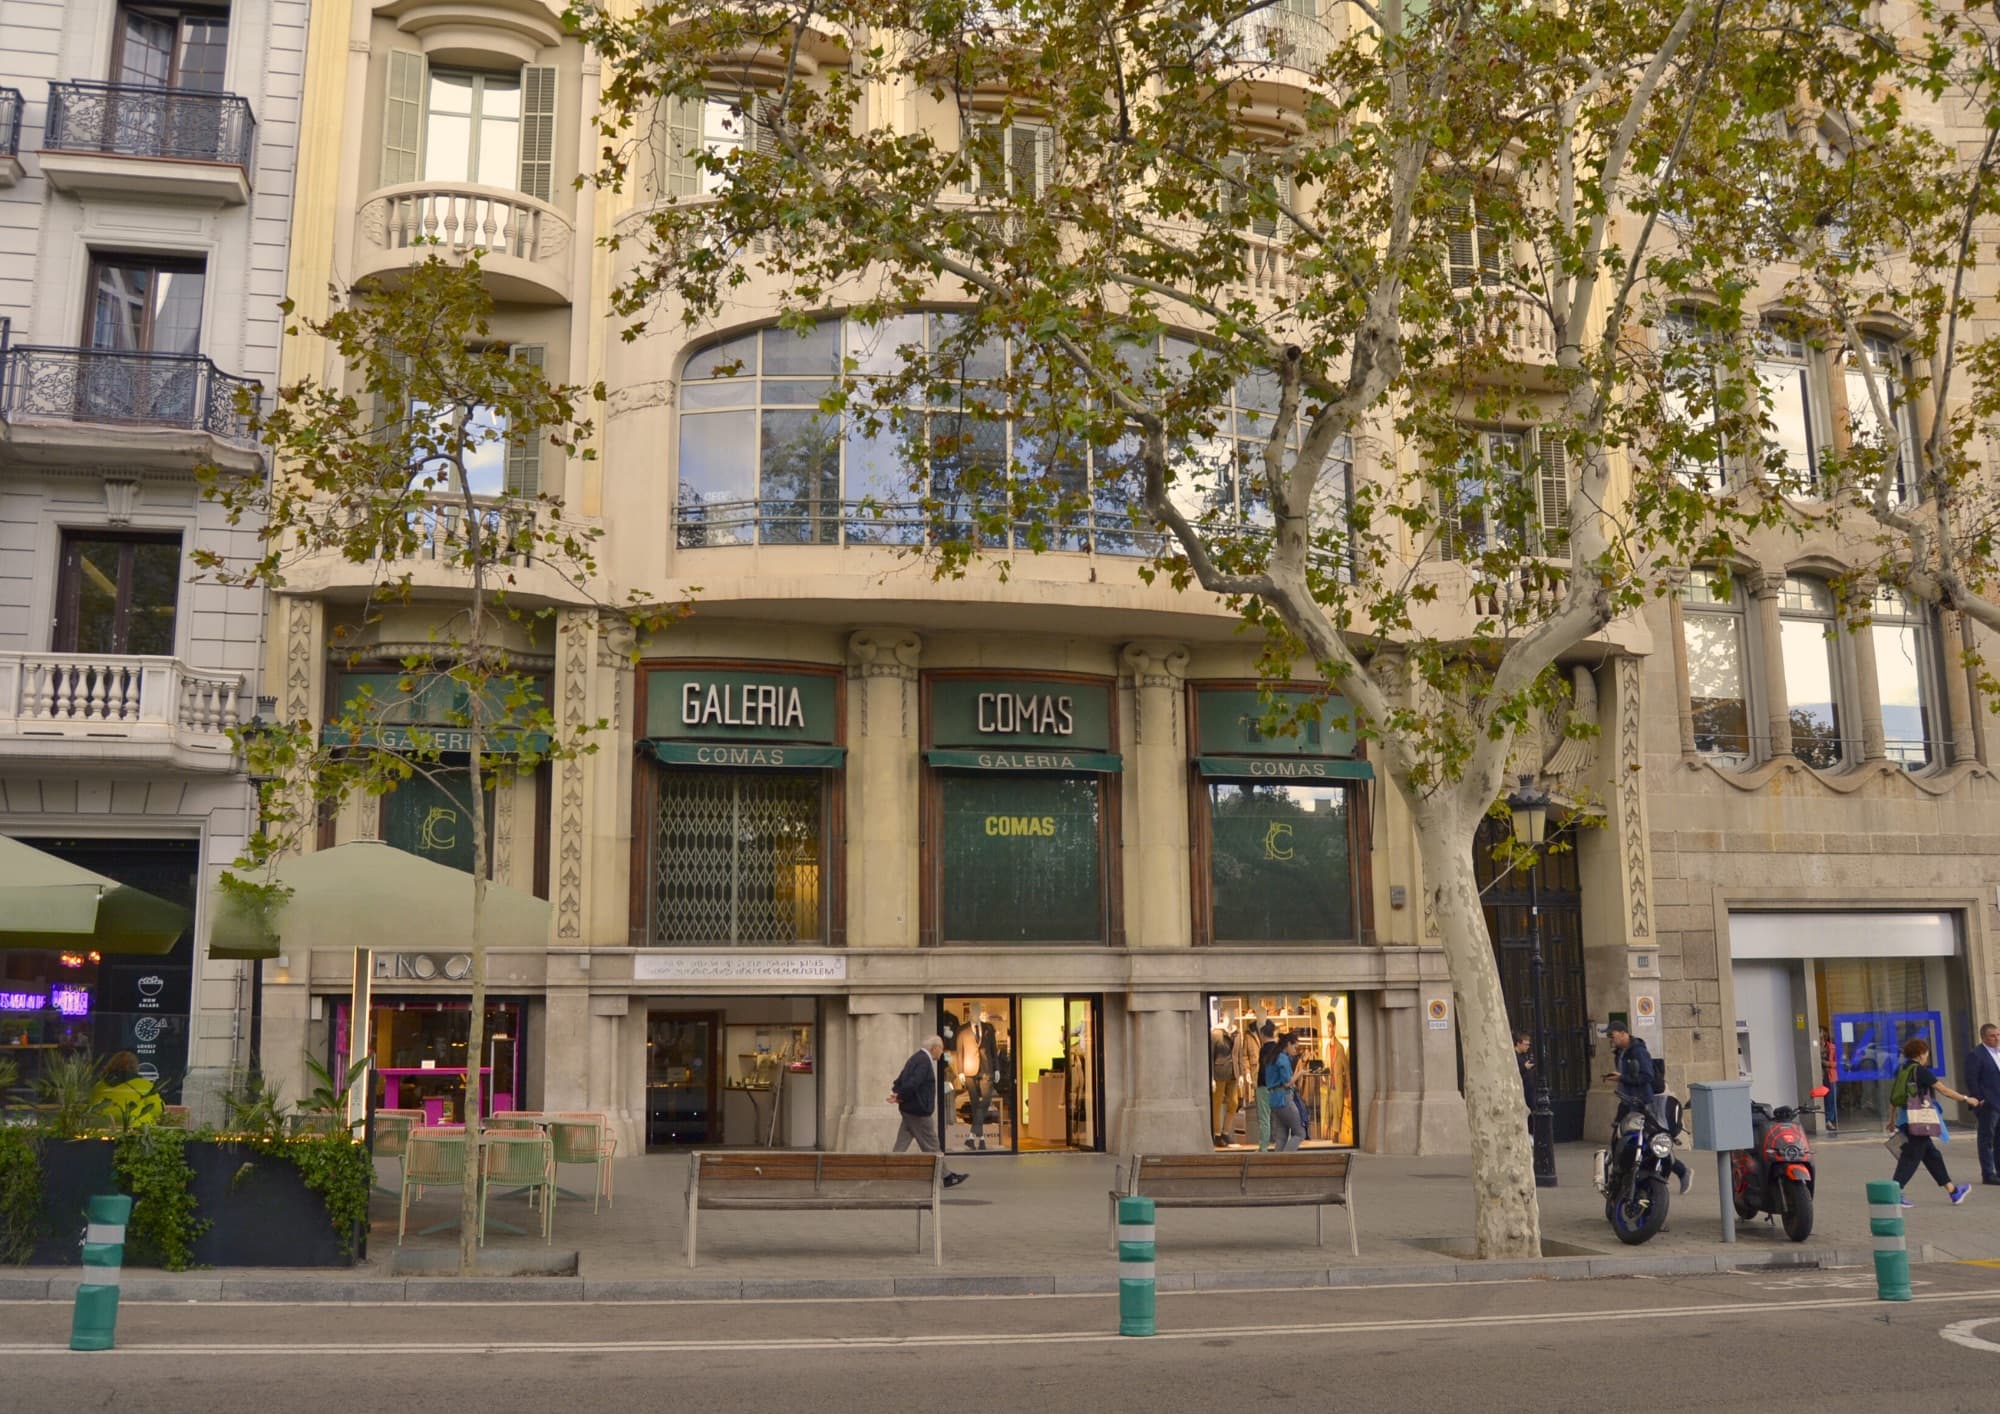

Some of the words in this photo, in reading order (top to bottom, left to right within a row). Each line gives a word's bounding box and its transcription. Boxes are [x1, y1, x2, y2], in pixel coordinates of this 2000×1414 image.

[682, 682, 804, 727] GALERIA
[978, 693, 1073, 734] COMAS
[697, 747, 784, 765] COMAS
[978, 754, 1075, 769] GALERIA
[1250, 761, 1326, 776] COMAS
[985, 815, 1056, 836] COMAS
